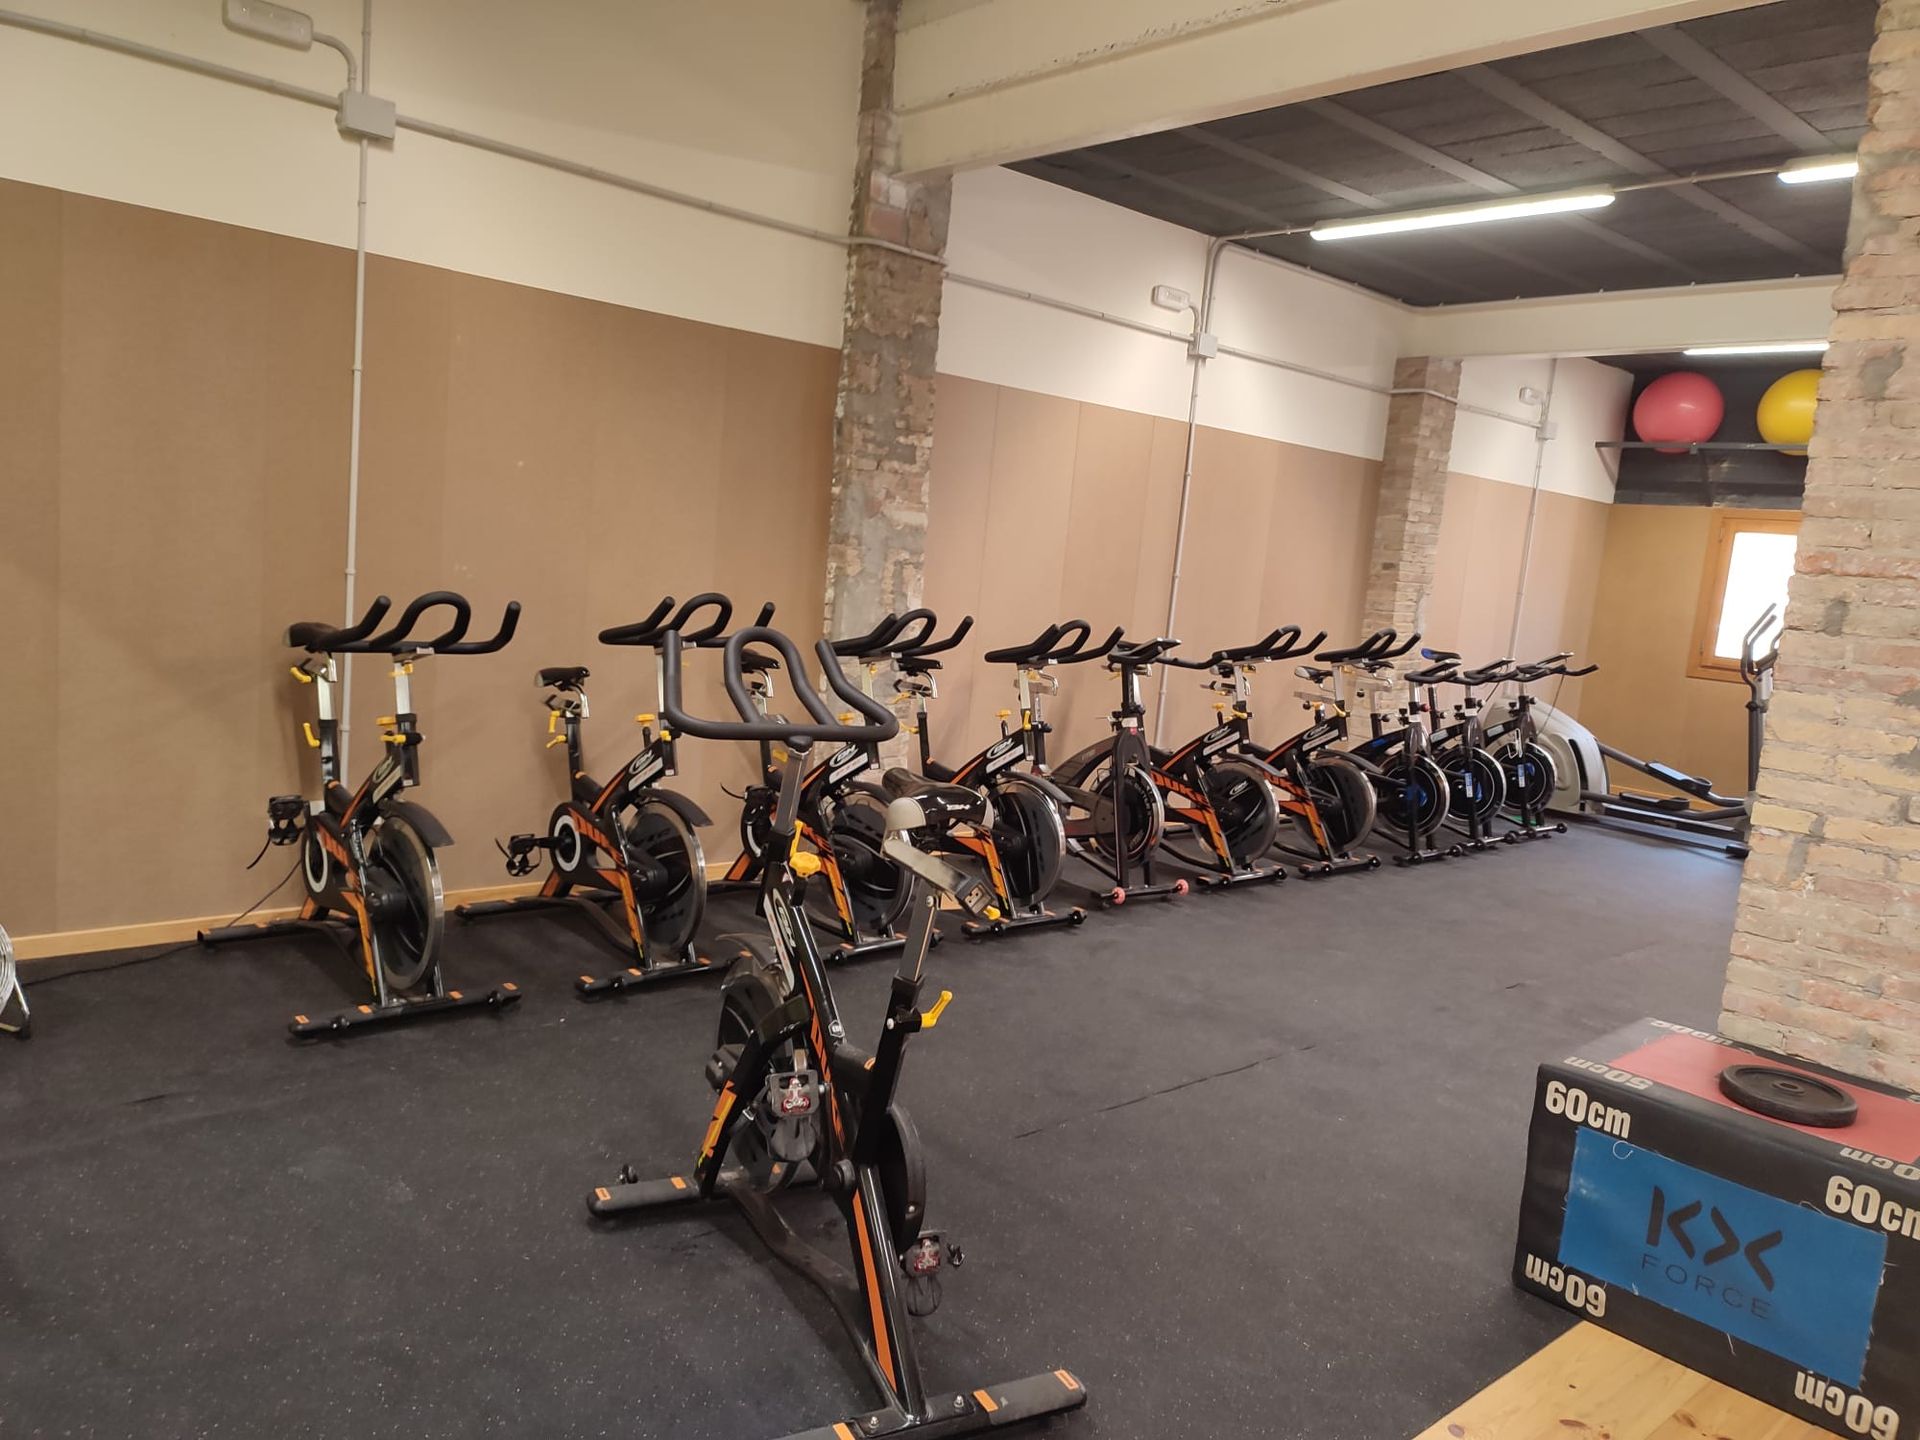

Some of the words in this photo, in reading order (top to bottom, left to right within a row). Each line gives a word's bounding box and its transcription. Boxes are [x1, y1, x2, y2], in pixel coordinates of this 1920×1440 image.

[1564, 1056, 1654, 1091] 50cm
[1544, 1081, 1632, 1140] 60cm
[1839, 1147, 1920, 1181] 0cm
[1525, 1253, 1608, 1319] 60cm
[1641, 1254, 1774, 1320] FORCE
[1794, 1370, 1900, 1440] 60cm
